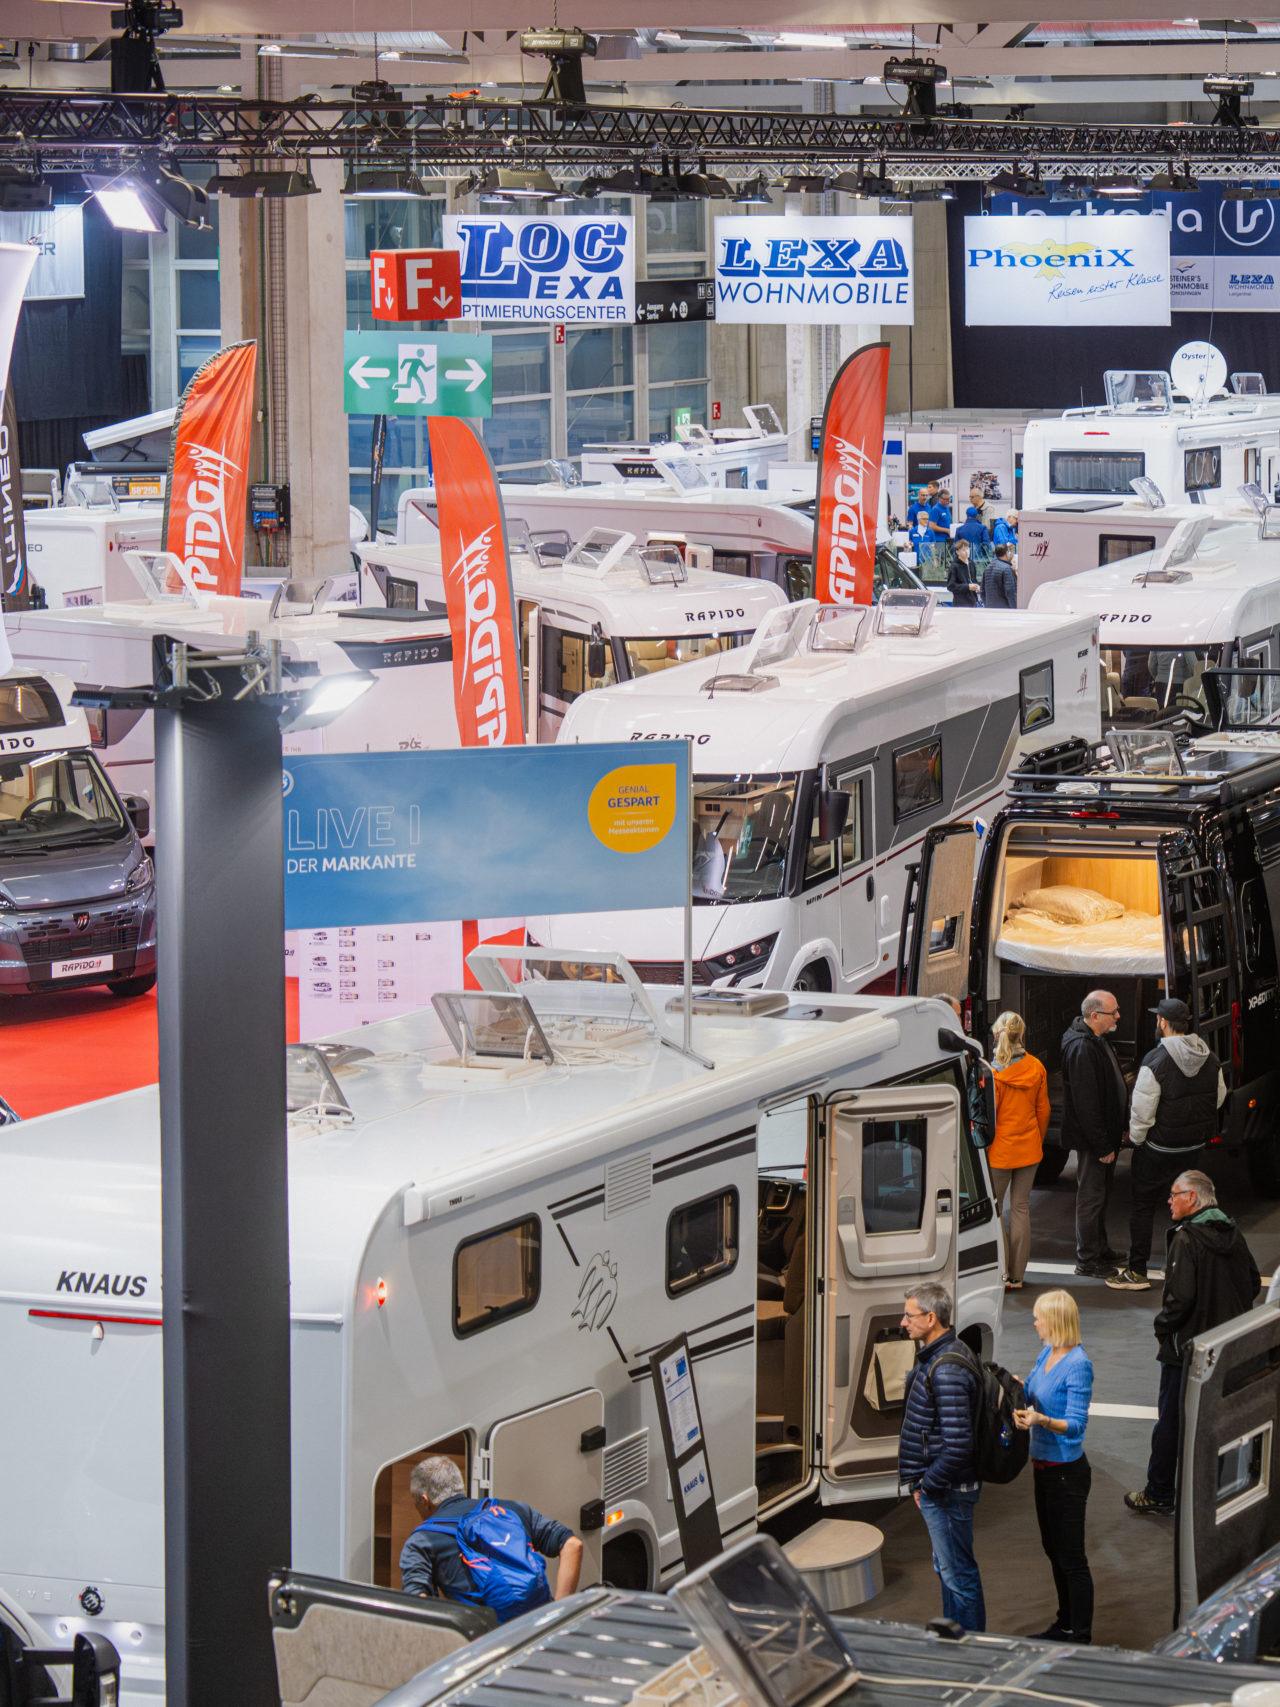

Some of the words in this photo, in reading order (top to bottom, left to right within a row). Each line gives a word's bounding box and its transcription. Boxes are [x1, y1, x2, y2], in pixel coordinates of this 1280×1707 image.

[457, 220, 628, 299] LOC
[717, 237, 909, 278] LEXA
[374, 257, 386, 310] F
[405, 258, 433, 310] F
[536, 276, 625, 300] EXA
[1047, 283, 1084, 302] Reisen
[1125, 273, 1165, 290] Klasse
[1229, 274, 1275, 285] LEXA
[717, 281, 909, 304] WOHNMOBILE
[461, 304, 627, 320] PTIMIERUNGSCENTER
[1181, 352, 1206, 361] Oyster
[626, 466, 658, 475] RAPID
[184, 480, 221, 586] PIDO
[828, 473, 862, 605] APIDO
[685, 608, 745, 622] RAPIDO
[1099, 613, 1152, 623] APIDO
[383, 647, 440, 664] RAPIDO
[0, 736, 35, 750] IDO
[618, 785, 650, 794] GENIAL
[607, 796, 661, 809] GESPART
[288, 806, 396, 851] LIVE
[287, 857, 318, 874] DER
[321, 853, 417, 873] MARKANTE
[56, 1270, 148, 1298] KNAUS
[683, 1476, 699, 1495] KNAUS
